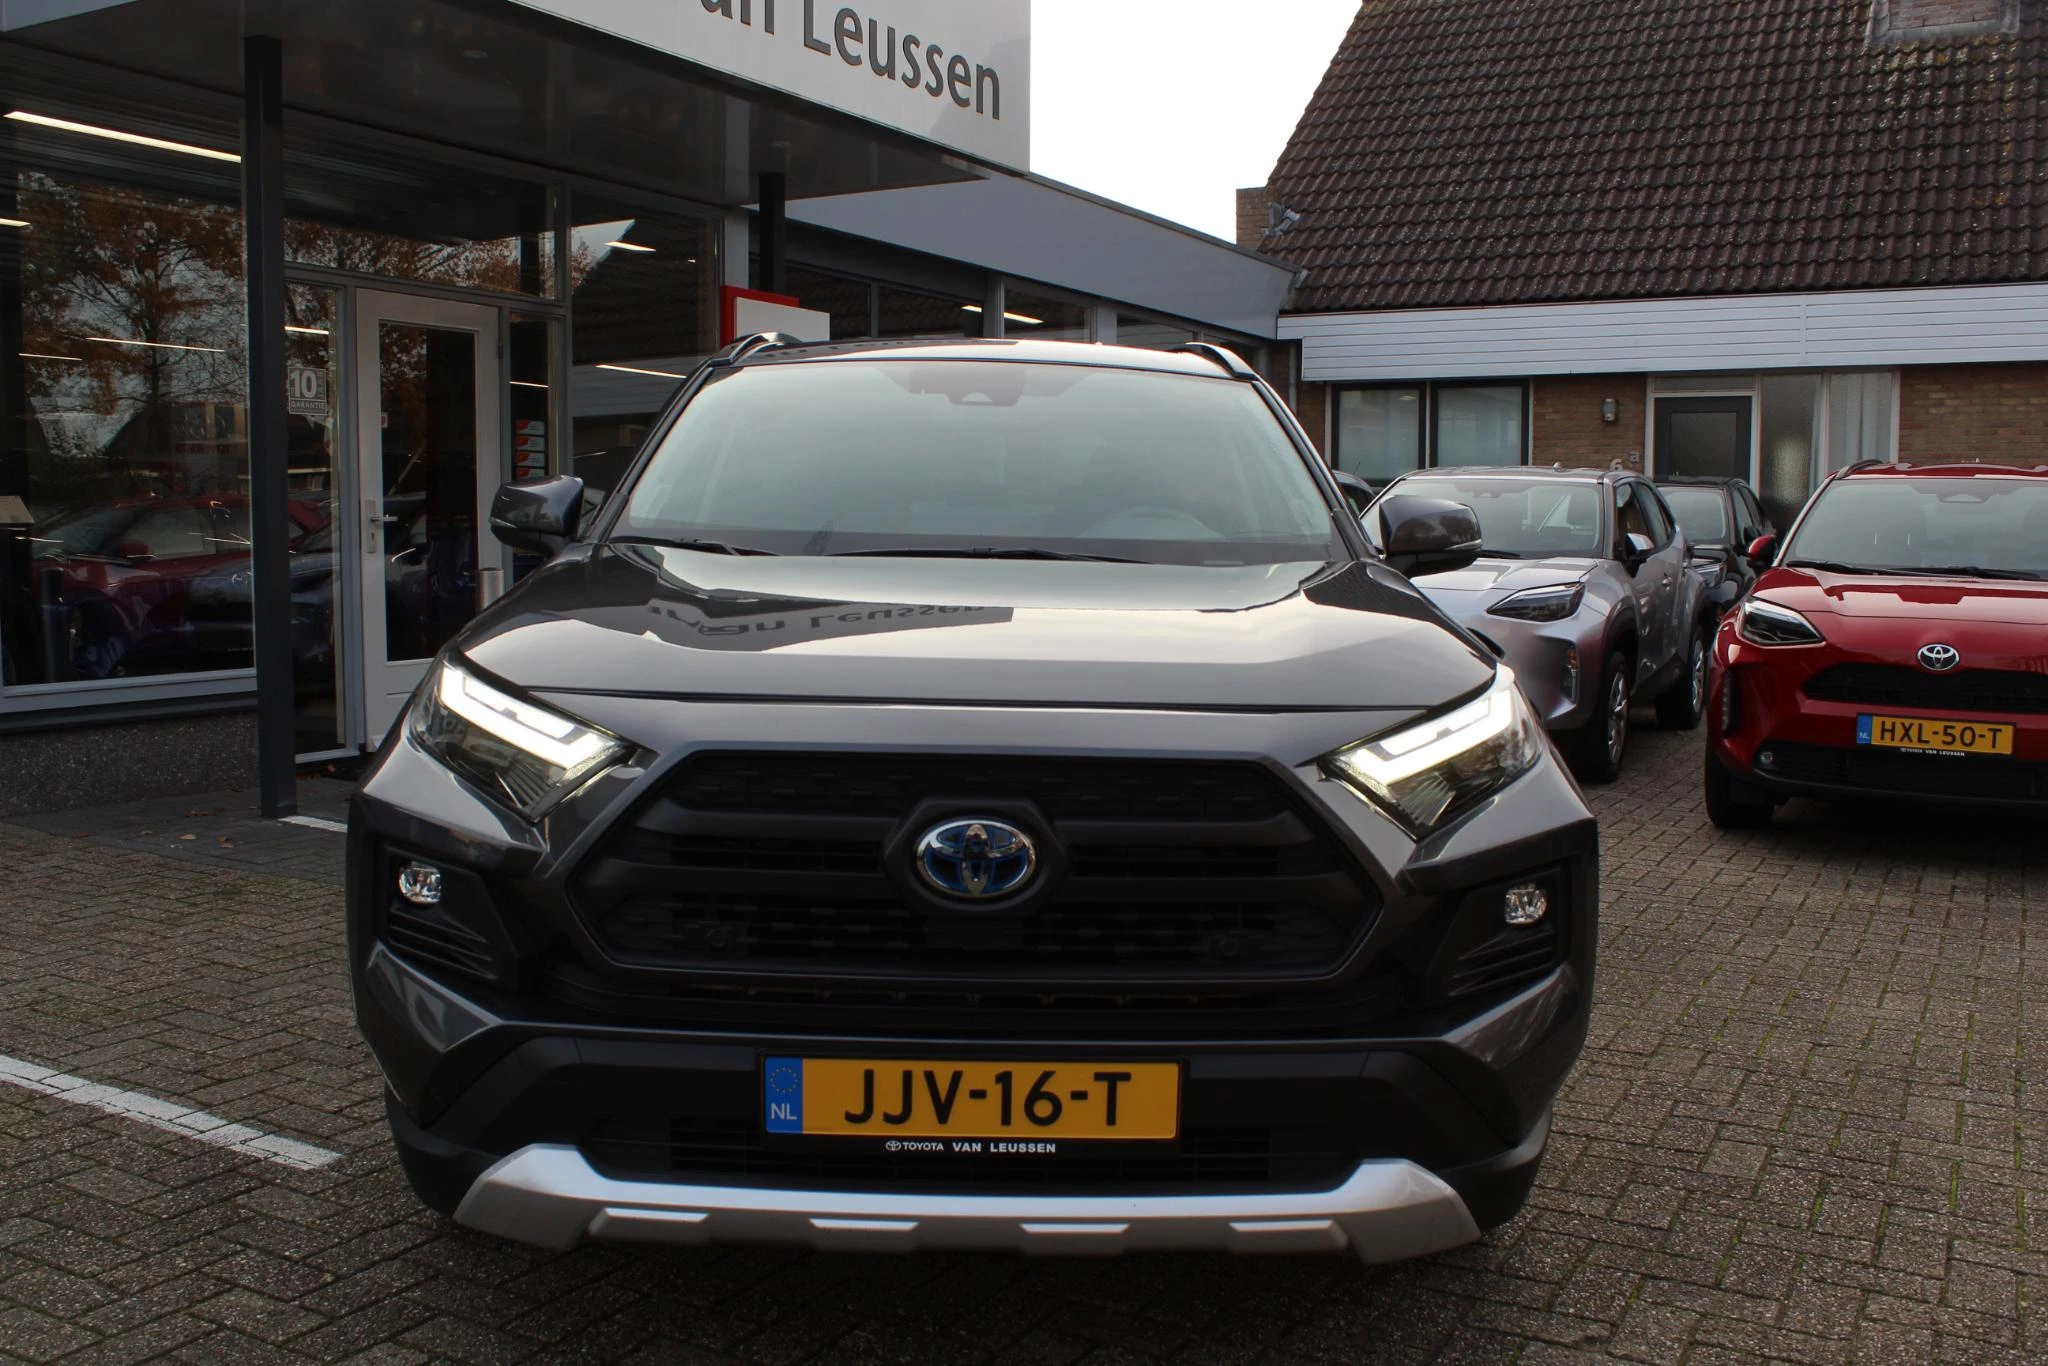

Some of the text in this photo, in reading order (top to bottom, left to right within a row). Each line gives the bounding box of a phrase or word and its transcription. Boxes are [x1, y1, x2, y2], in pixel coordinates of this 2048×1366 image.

[803, 0, 1000, 120] Leussen
[290, 370, 317, 398] 10
[291, 401, 327, 409] GARANTIE
[1859, 731, 1870, 740] NL
[1879, 721, 2003, 749] HXL-50-T
[844, 1069, 1132, 1127] JJV-16-T
[770, 1103, 798, 1121] NL
[902, 1142, 1056, 1153] TOYOTA VAN LEUSSEN
